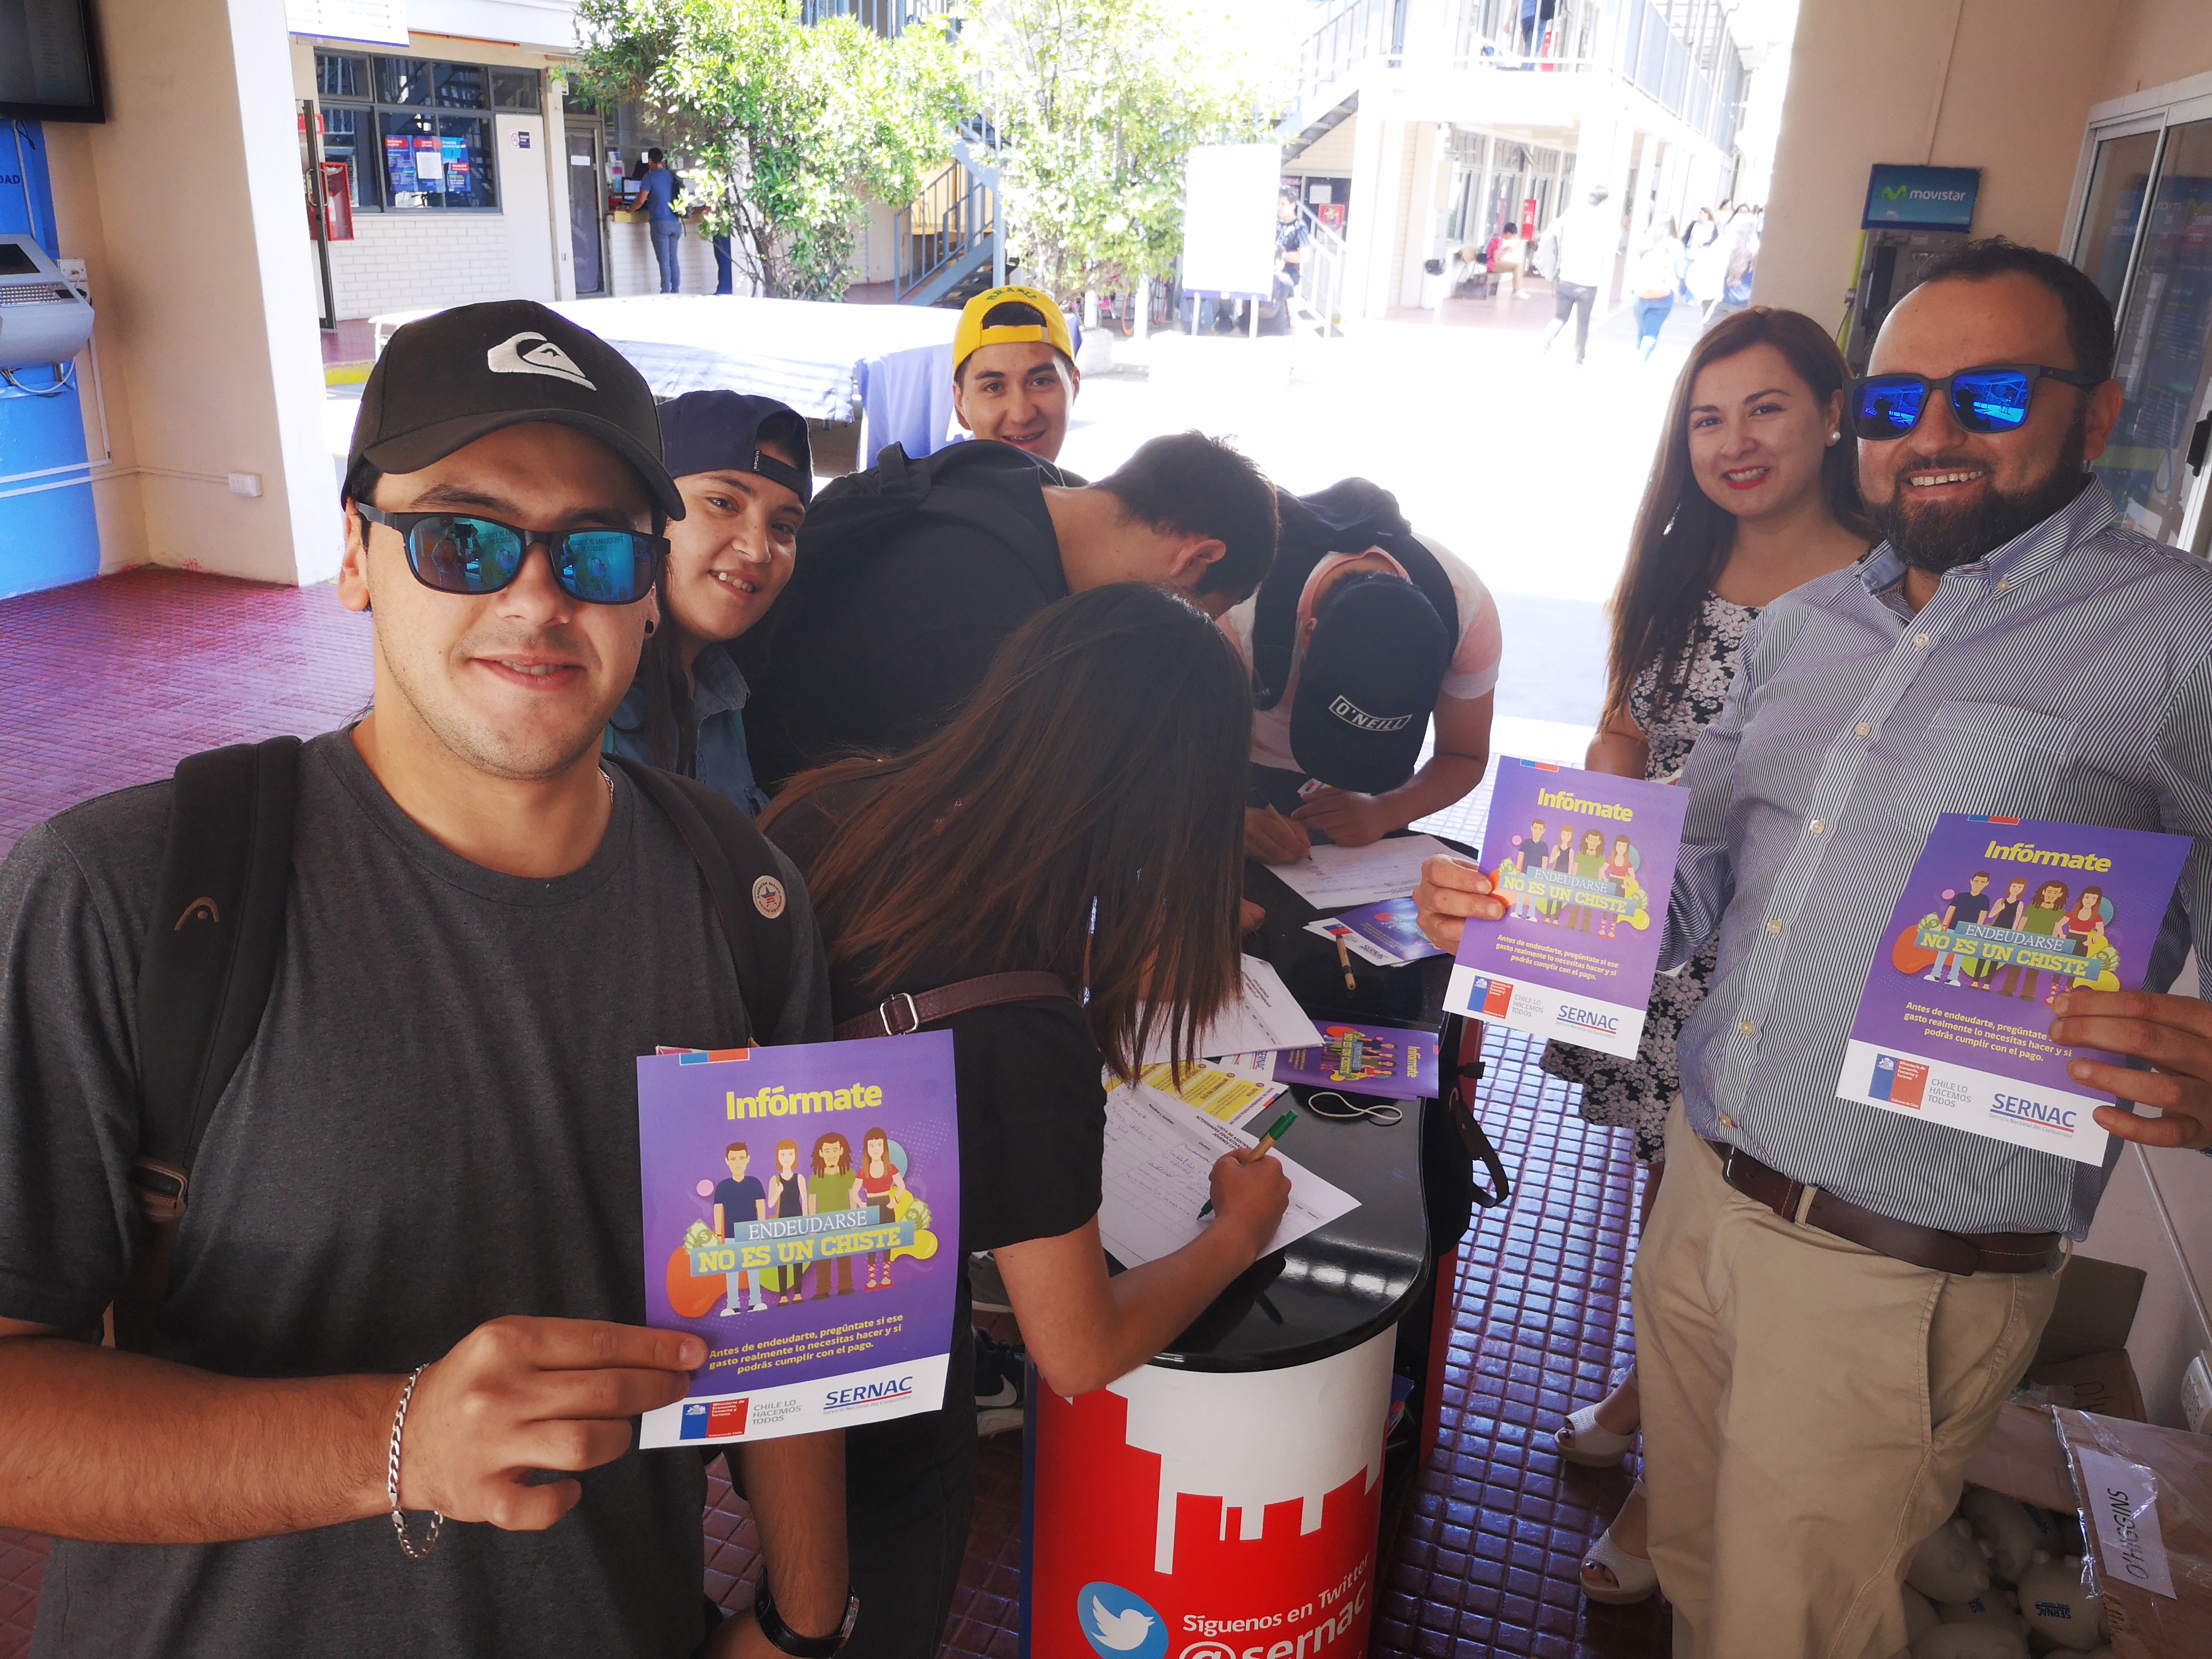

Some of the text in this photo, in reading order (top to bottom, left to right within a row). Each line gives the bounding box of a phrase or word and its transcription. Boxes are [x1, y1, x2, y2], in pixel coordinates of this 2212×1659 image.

[1909, 190, 1966, 201] movistar
[986, 287, 1037, 301] BRASIL
[1336, 702, 1402, 729] O'NEILL
[1537, 788, 1633, 822] Infórmate
[1984, 841, 2111, 872] Infórmate
[1503, 877, 1627, 913] NO ES UN CHISTE
[1535, 869, 1607, 893] ENDEUDARSE
[1497, 935, 1515, 944] Antes
[1526, 943, 1563, 955] endeudarte,
[1564, 951, 1599, 963] pregúntate
[1966, 924, 2064, 951] ENDEUDARSE
[1496, 943, 1514, 951] gasto
[1514, 947, 1546, 959] realmente
[1555, 958, 1584, 968] necesitas
[1586, 964, 1604, 973] hacer
[1511, 955, 1532, 964] podrás
[1534, 961, 1558, 971] cumplir
[1920, 933, 2089, 976] NO ES UN CHISTE
[1512, 1007, 1532, 1017] TODOS
[1513, 1001, 1543, 1013] HACEMOS
[1515, 995, 1532, 1003] CHILE
[1559, 1005, 1619, 1030] SERNAC
[1904, 1012, 1927, 1023] gasto
[1929, 1018, 1972, 1034] realmente
[1985, 1031, 2027, 1046] necesitas
[2029, 1040, 2054, 1052] hacer
[1906, 1002, 1930, 1014] Antes
[1944, 1012, 1995, 1030] endeudarte,
[1997, 1023, 2046, 1040] pregúntate
[1924, 1027, 2044, 1061] podrás cumplir con el pago.
[1407, 1046, 1420, 1078] Infórmate
[726, 1082, 882, 1120] Infórmate
[1928, 1095, 1956, 1107] TODOS
[1929, 1087, 1971, 1103] HACEMOS
[1992, 1093, 2077, 1128] SERNAC
[749, 1210, 867, 1240] ENDEUDARSE
[699, 1227, 900, 1273] NO ES UN CHISTE
[709, 1314, 903, 1358] Antes de endeudarte, pregúntate si ese
[709, 1357, 738, 1370] gasto
[740, 1347, 793, 1363] realmente
[808, 1335, 854, 1350] necesitas
[856, 1329, 883, 1340] hacer
[885, 1328, 891, 1336] y
[894, 1324, 901, 1332] si
[738, 1361, 772, 1374] podrás
[775, 1353, 814, 1366] cumplir
[817, 1349, 834, 1358] con
[848, 1343, 874, 1354] pago.
[825, 1376, 913, 1405] SERNAC
[753, 1406, 801, 1418] HACEMOS
[753, 1415, 784, 1424] TODOS
[754, 1401, 782, 1410] CHILE
[2107, 1488, 2148, 1579] O'HIGGINS
[1183, 1551, 1369, 1637] Síguenos en Twitter
[2036, 1607, 2070, 1619] SERNAC
